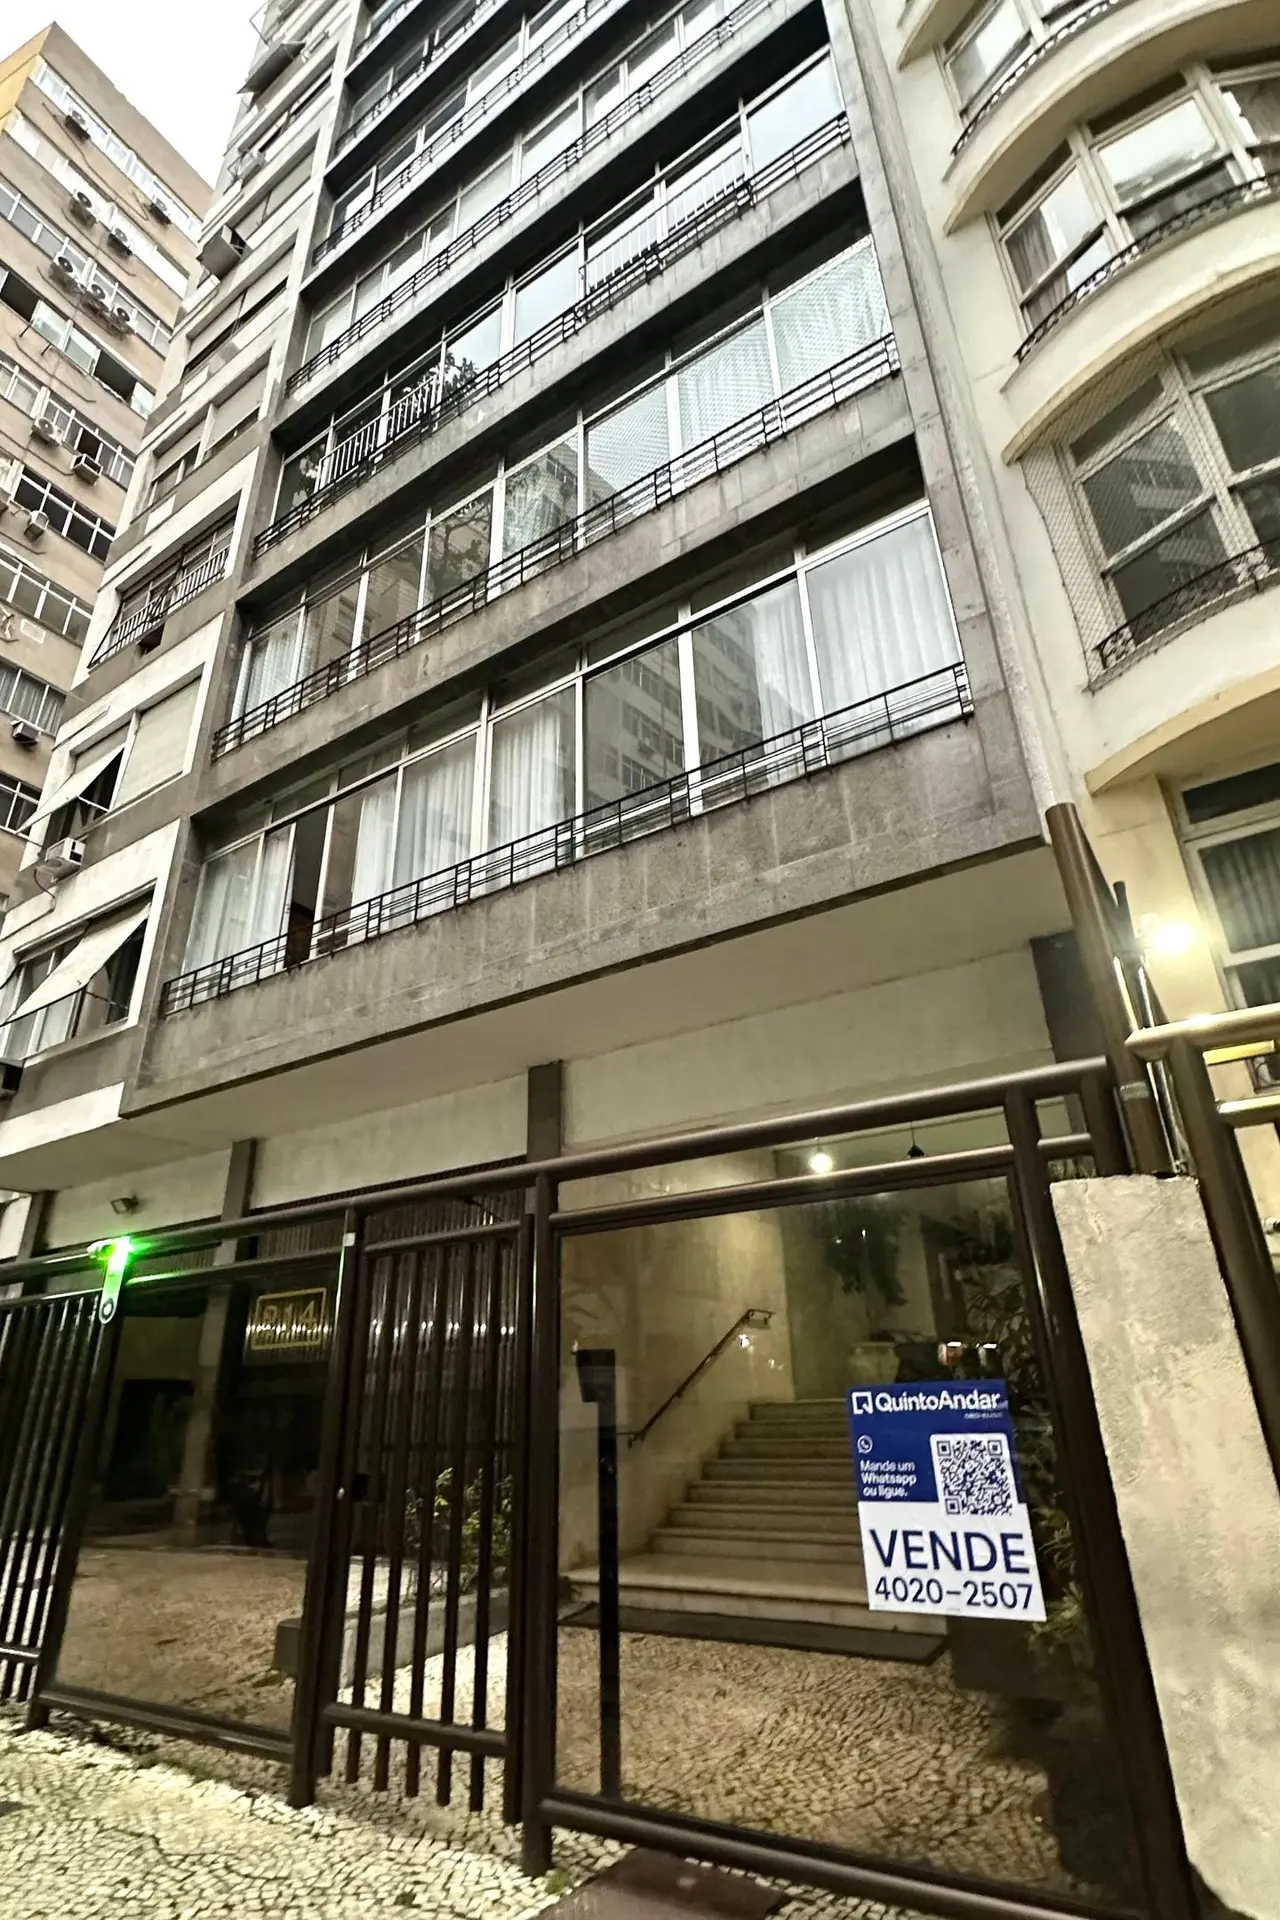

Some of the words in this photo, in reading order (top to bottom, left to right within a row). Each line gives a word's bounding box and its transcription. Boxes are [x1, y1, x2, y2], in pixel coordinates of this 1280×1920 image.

[875, 1389, 1001, 1412] QuintoAndar
[860, 1459, 896, 1472] Mande
[897, 1461, 915, 1472] um
[863, 1486, 877, 1497] ou
[870, 1529, 1030, 1574] VENDE
[875, 1576, 1033, 1610] 4020-2507
